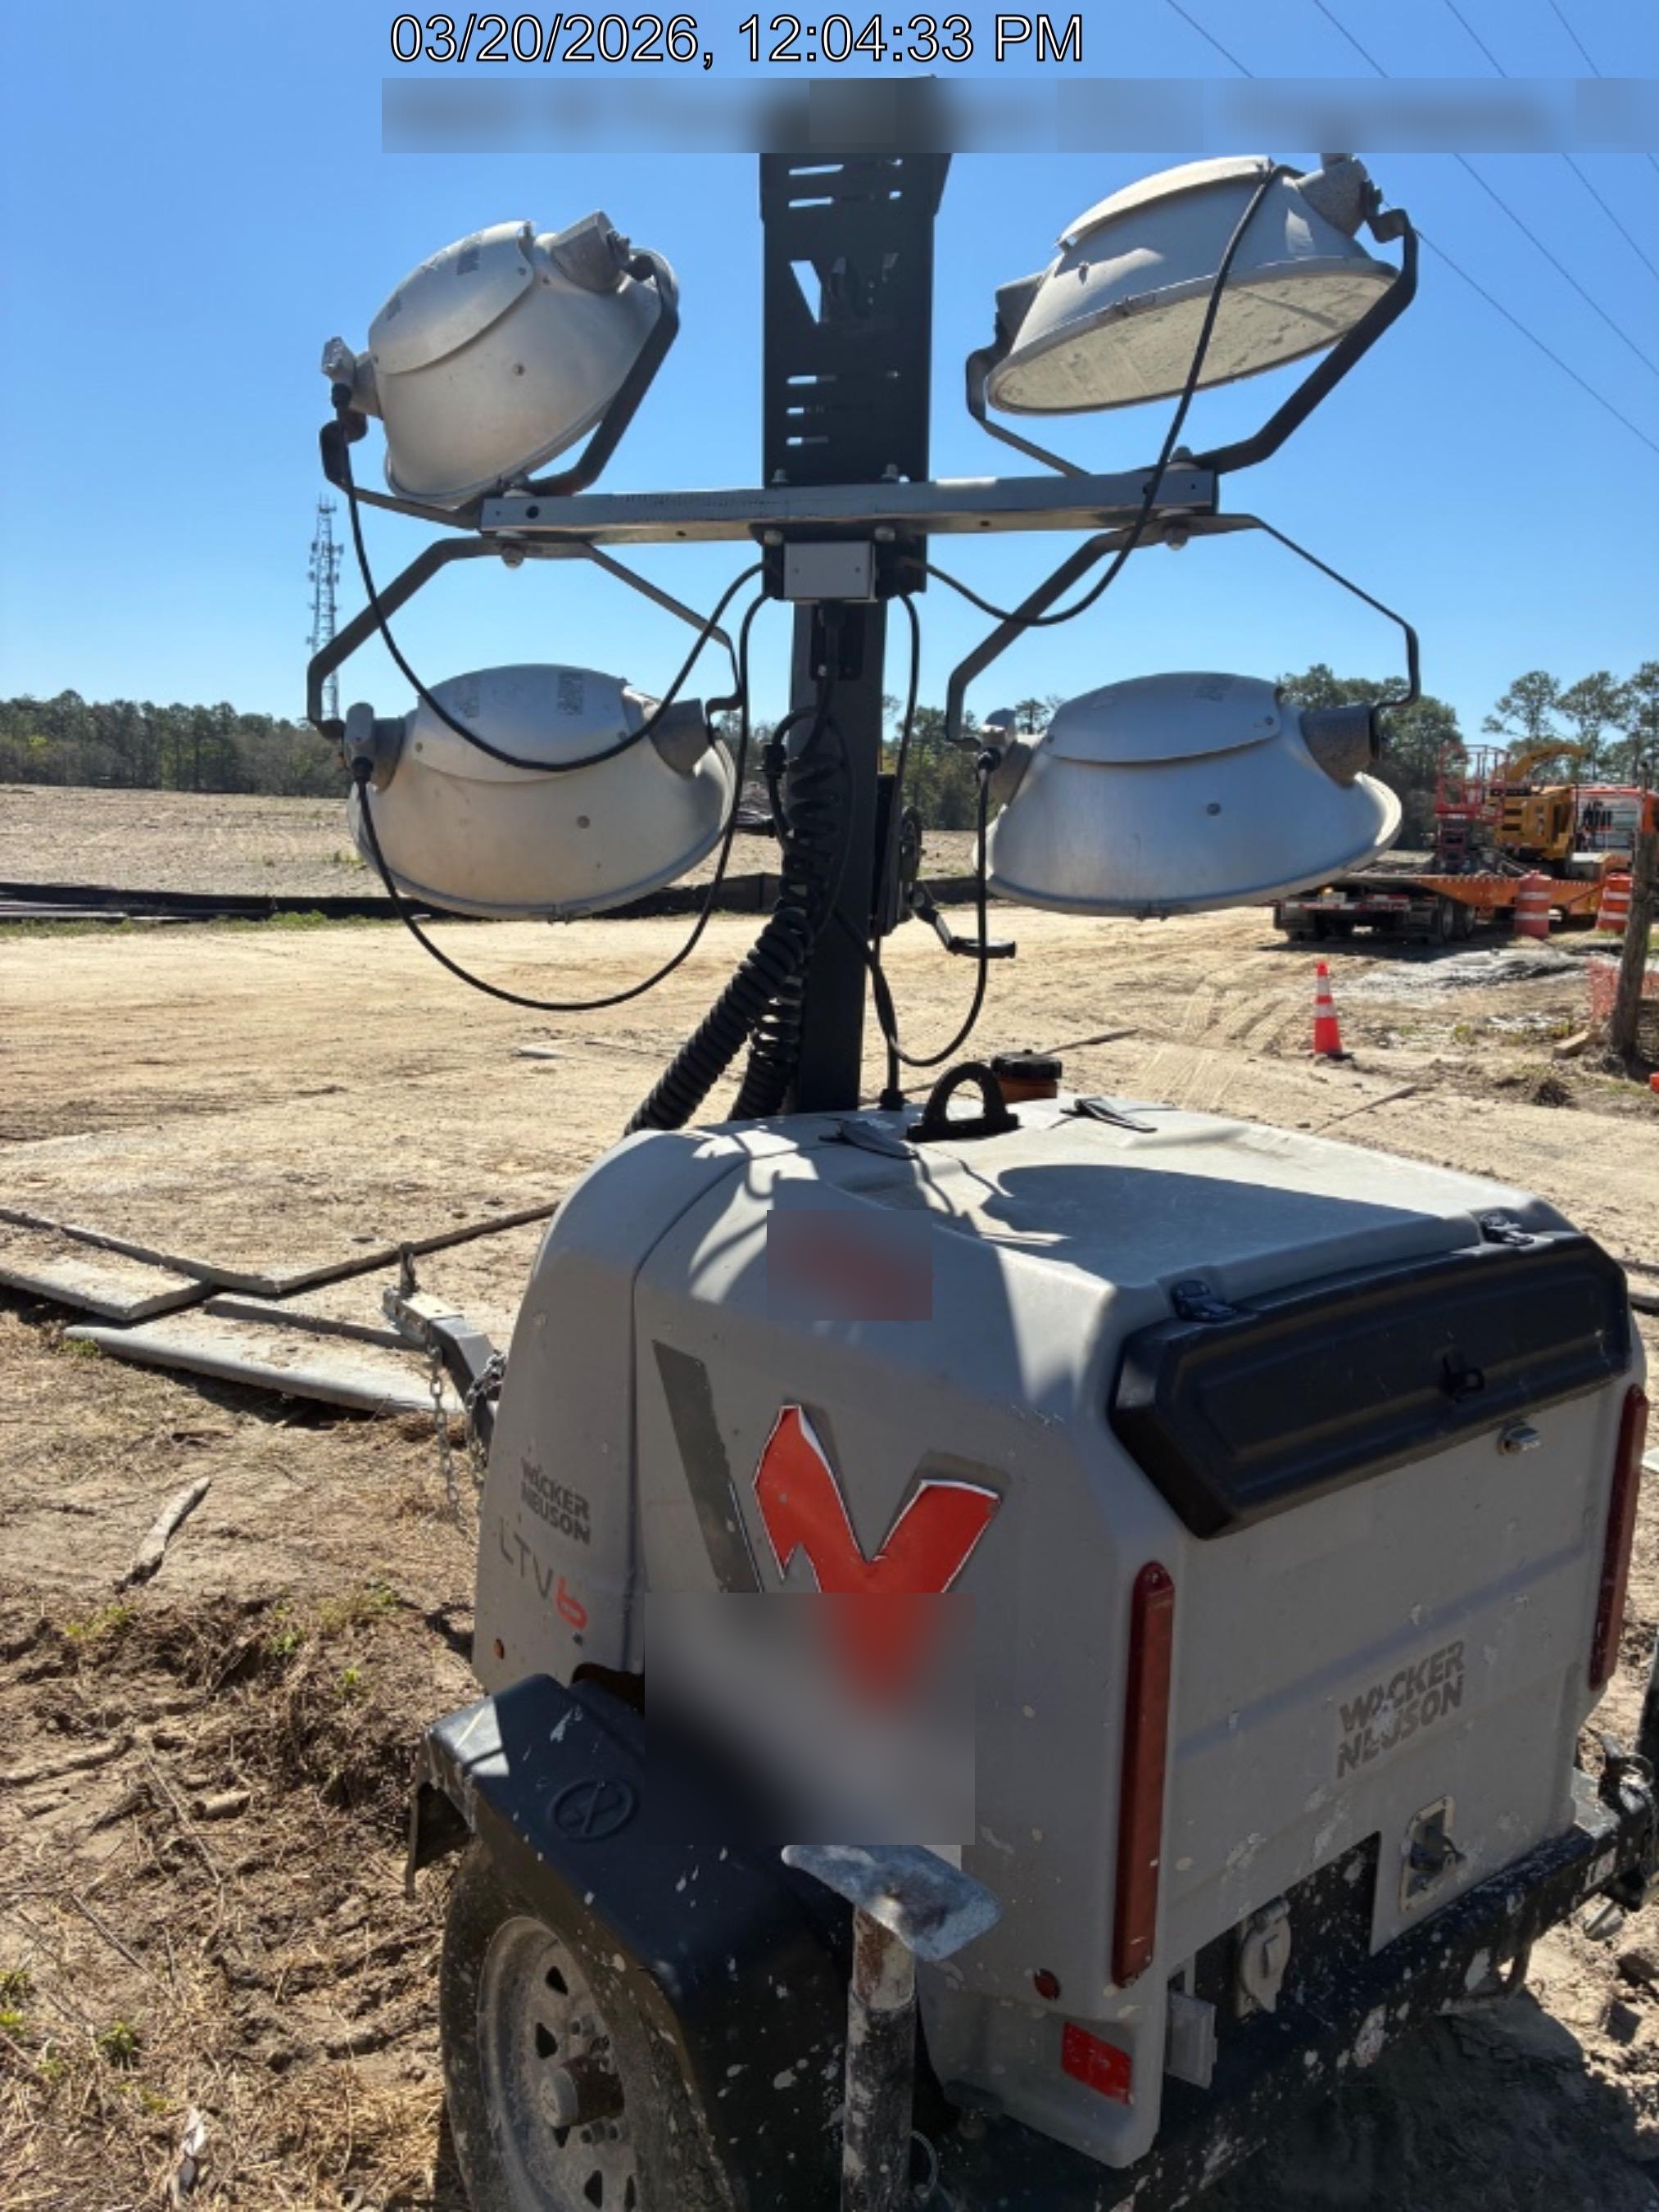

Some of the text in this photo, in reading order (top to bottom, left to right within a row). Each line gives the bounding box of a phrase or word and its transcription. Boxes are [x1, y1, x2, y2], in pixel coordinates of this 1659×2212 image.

[520, 1480, 591, 1546] NEUSON
[521, 1456, 590, 1521] WACKER
[1339, 1640, 1465, 1732] WACKER
